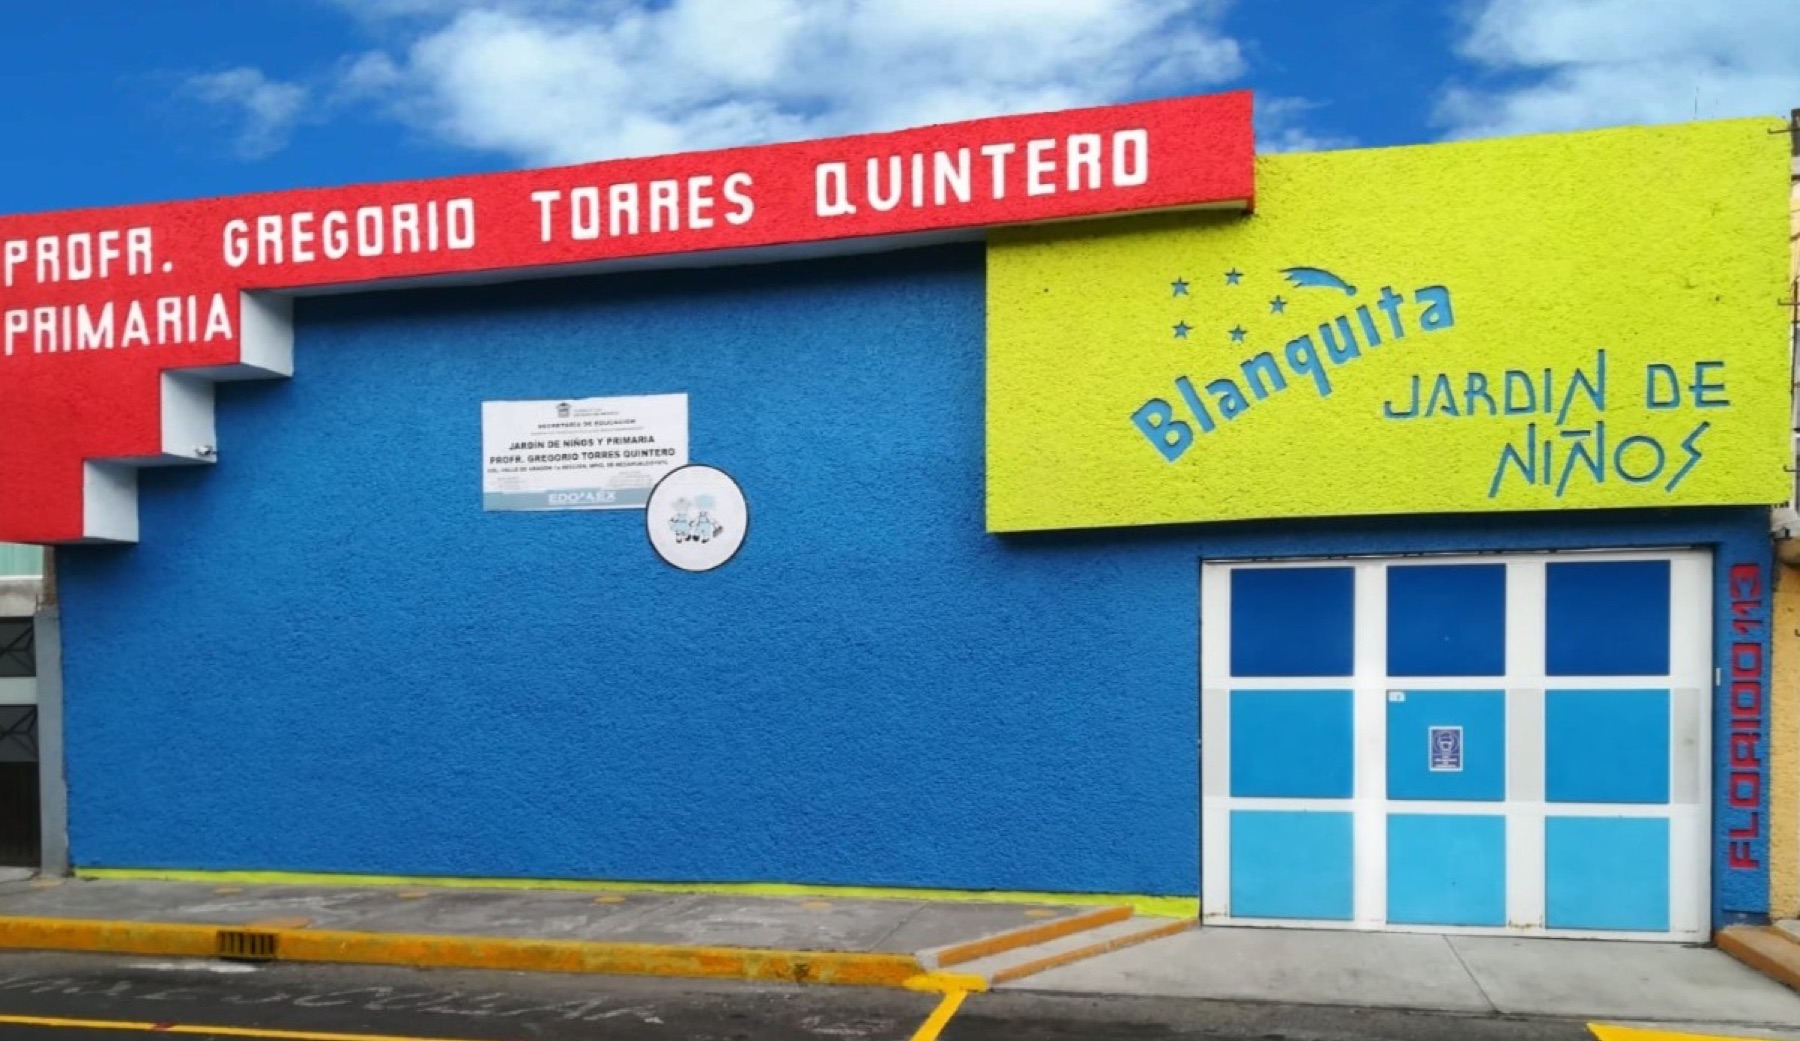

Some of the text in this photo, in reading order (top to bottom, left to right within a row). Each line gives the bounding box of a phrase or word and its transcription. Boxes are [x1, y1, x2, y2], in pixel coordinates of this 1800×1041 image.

[4, 128, 1149, 286] PROFR. GREGORIO TORRES QUINTERO
[4, 293, 233, 355] PRIMARIA
[1130, 284, 1455, 463] Blanquita
[1384, 349, 1730, 426] JARDIN DE
[527, 453, 579, 462] GREGORIO
[581, 450, 621, 460] TORRES
[623, 448, 676, 458] QUINTERO
[547, 440, 560, 449] DE
[597, 438, 604, 446] Y
[606, 435, 655, 446] PRIMARIA
[1488, 420, 1710, 498] NIÑOS
[1728, 563, 1763, 870] FLORIDO 113
